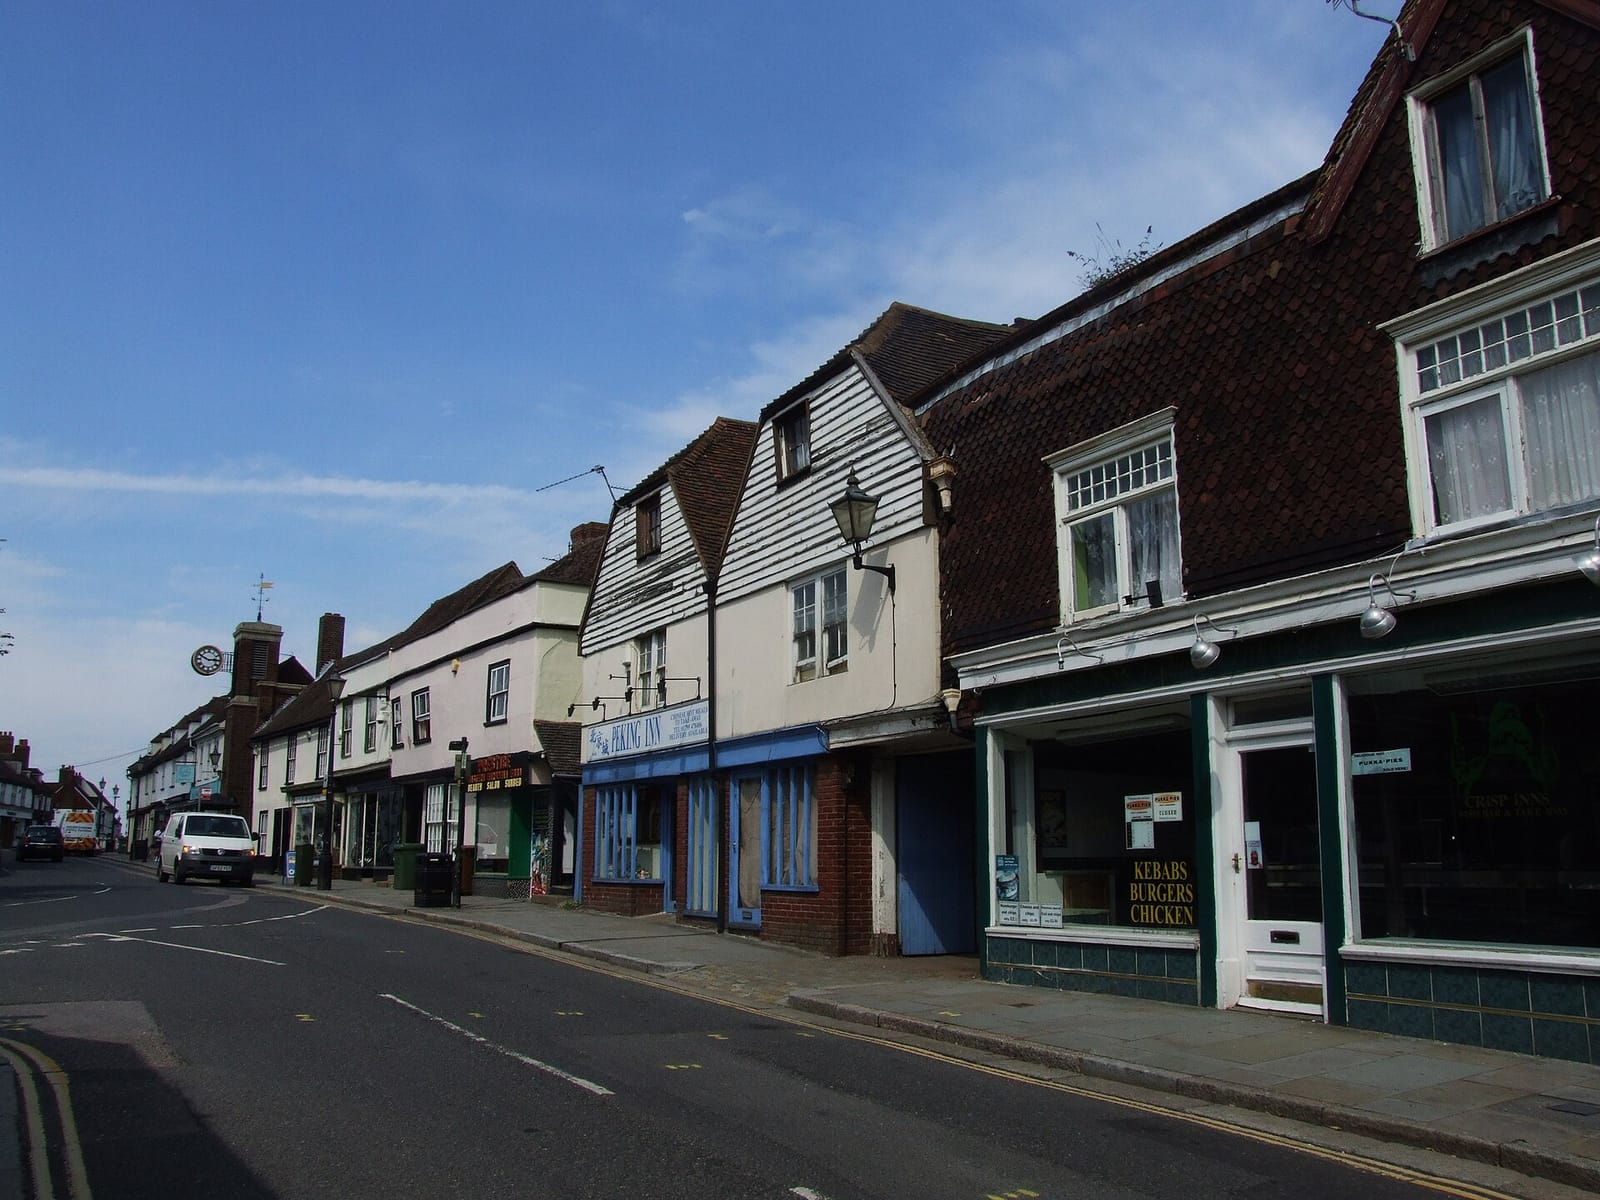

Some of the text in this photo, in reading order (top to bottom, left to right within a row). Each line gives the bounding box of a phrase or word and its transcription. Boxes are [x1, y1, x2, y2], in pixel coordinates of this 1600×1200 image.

[611, 715, 662, 752] PEKING INN
[1134, 861, 1188, 881] KEBABS
[1130, 883, 1194, 903] BURGERS
[1130, 905, 1194, 925] CHICKEN
